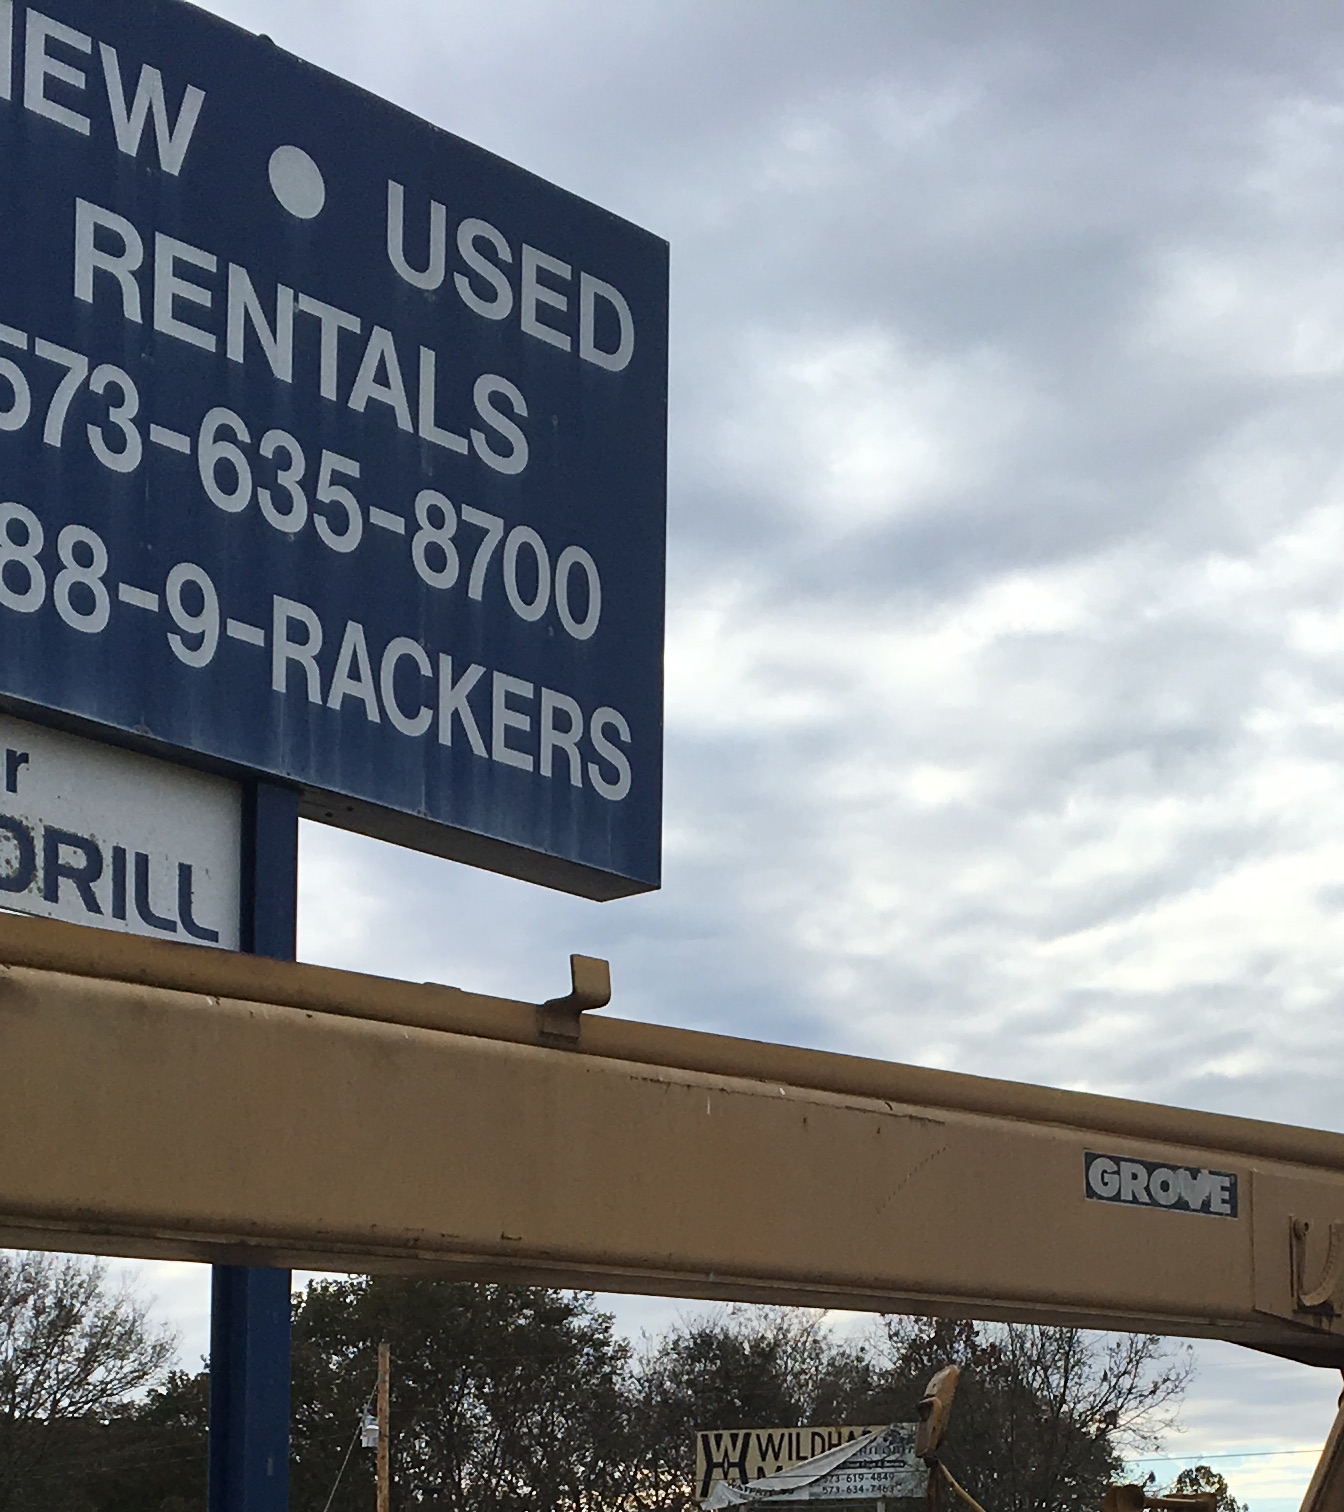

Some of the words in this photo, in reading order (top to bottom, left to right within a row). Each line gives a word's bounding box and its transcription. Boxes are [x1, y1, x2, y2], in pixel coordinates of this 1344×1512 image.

[75, 198, 529, 475] RENTALS
[387, 180, 635, 371] USED
[1088, 1157, 1231, 1214] GROVE
